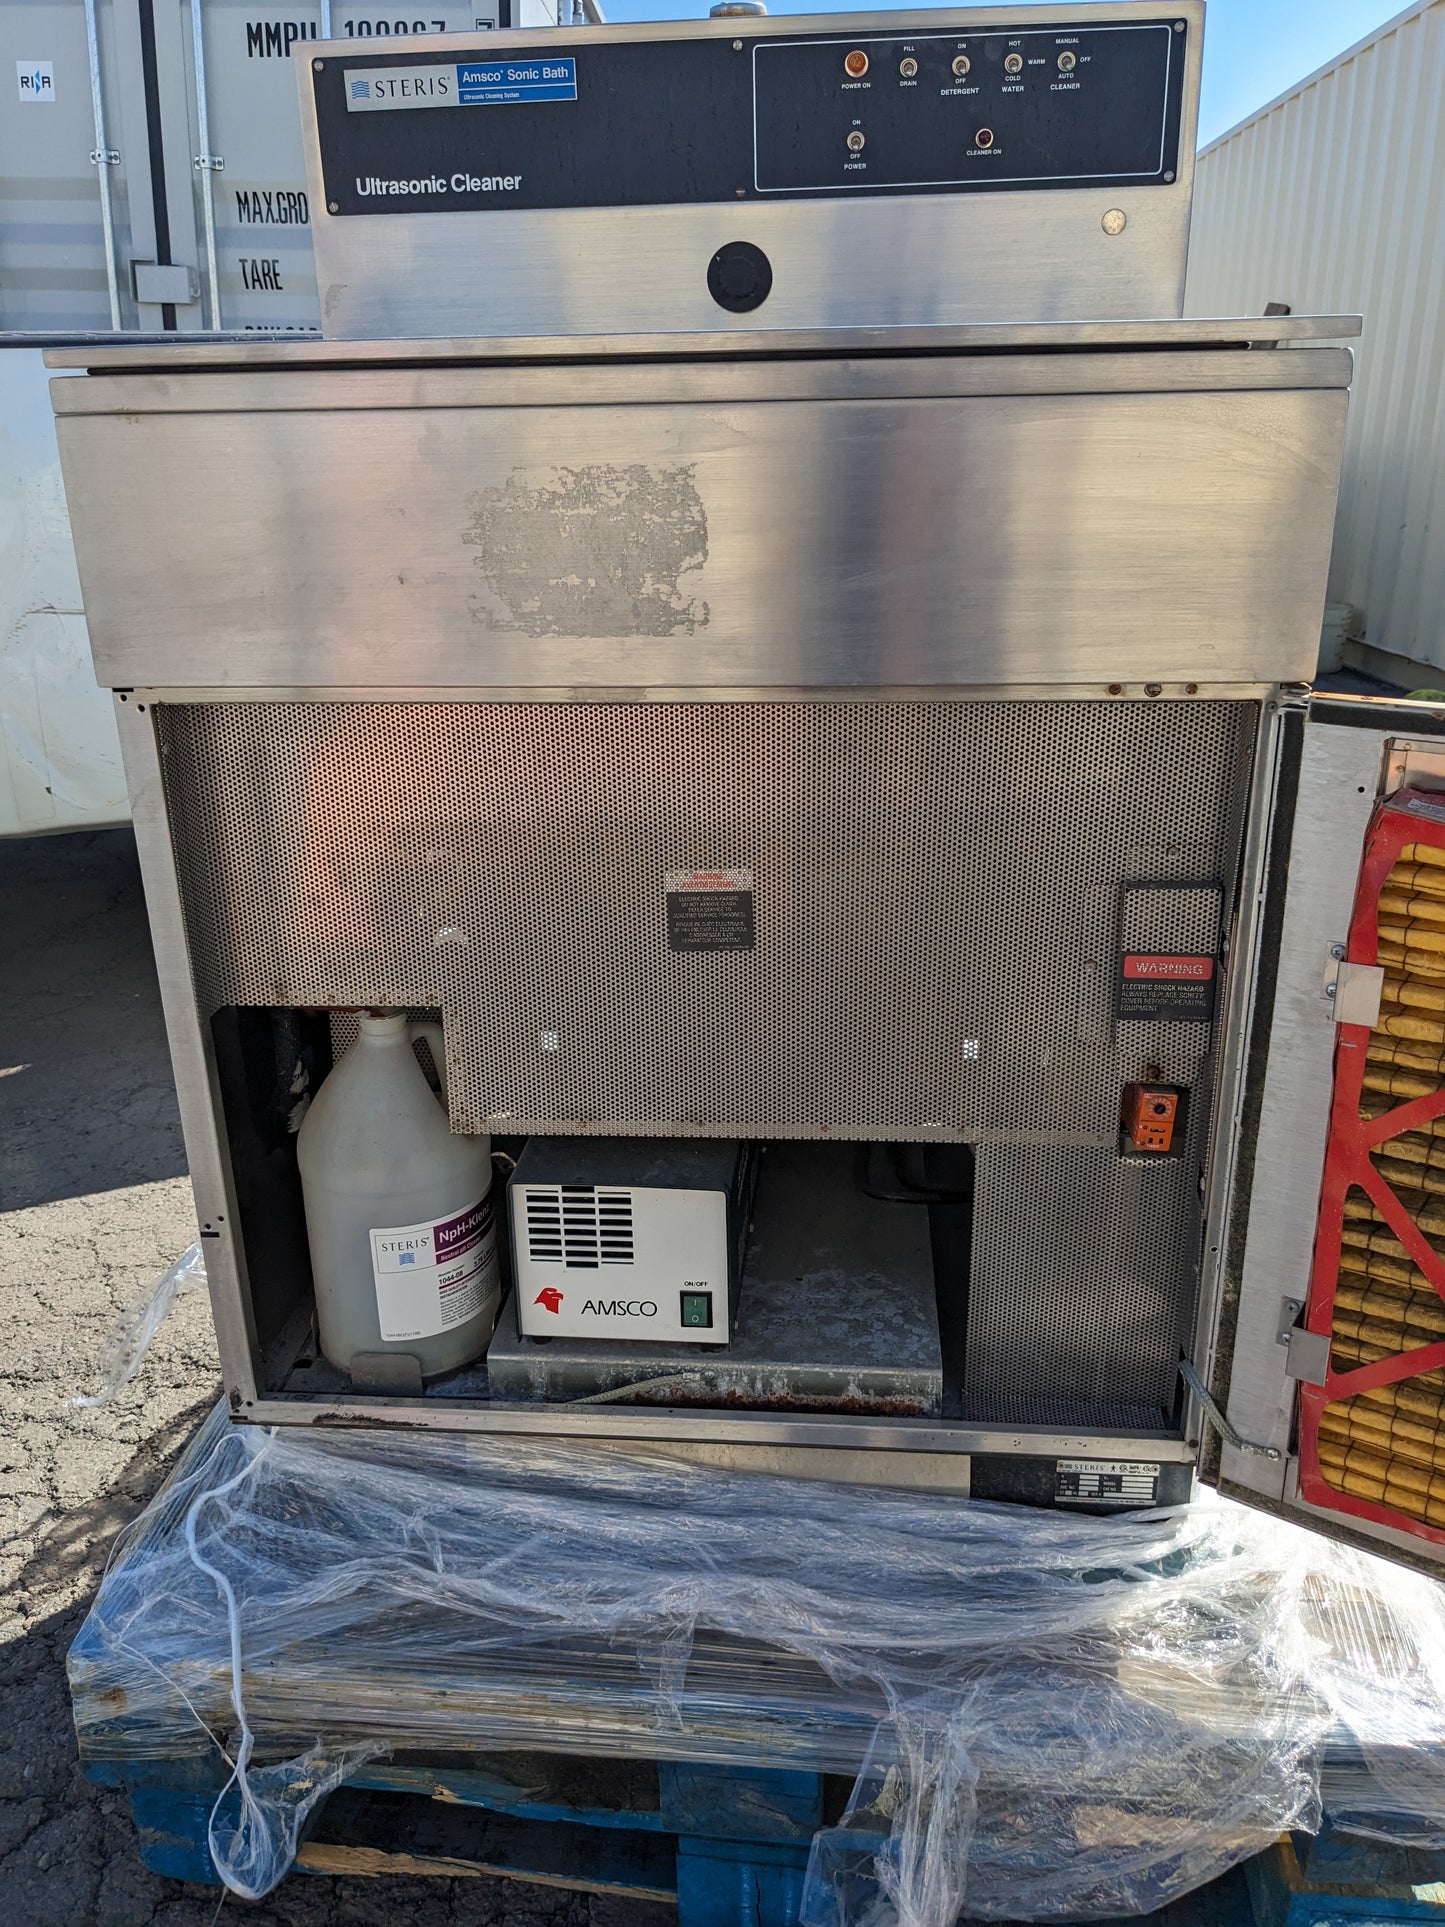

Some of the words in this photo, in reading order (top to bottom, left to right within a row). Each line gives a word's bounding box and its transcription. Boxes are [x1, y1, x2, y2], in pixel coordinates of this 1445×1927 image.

[507, 68, 539, 81] Sonic
[542, 66, 569, 79] Bath
[376, 77, 450, 98] STERIS
[940, 88, 980, 96] DETERGENT
[1001, 85, 1025, 93] WATER
[1050, 83, 1081, 91] CLEANER
[355, 175, 448, 196] Ultrasonic
[450, 173, 522, 192] Cleaner
[235, 191, 311, 224] MAX.GRO
[239, 258, 283, 290] TARE
[1136, 962, 1203, 975] WARNING
[1170, 999, 1207, 1007] OPERATING
[381, 1237, 429, 1252] STERIS
[440, 1248, 460, 1262] Neutral
[581, 1300, 658, 1317] AMSCO
